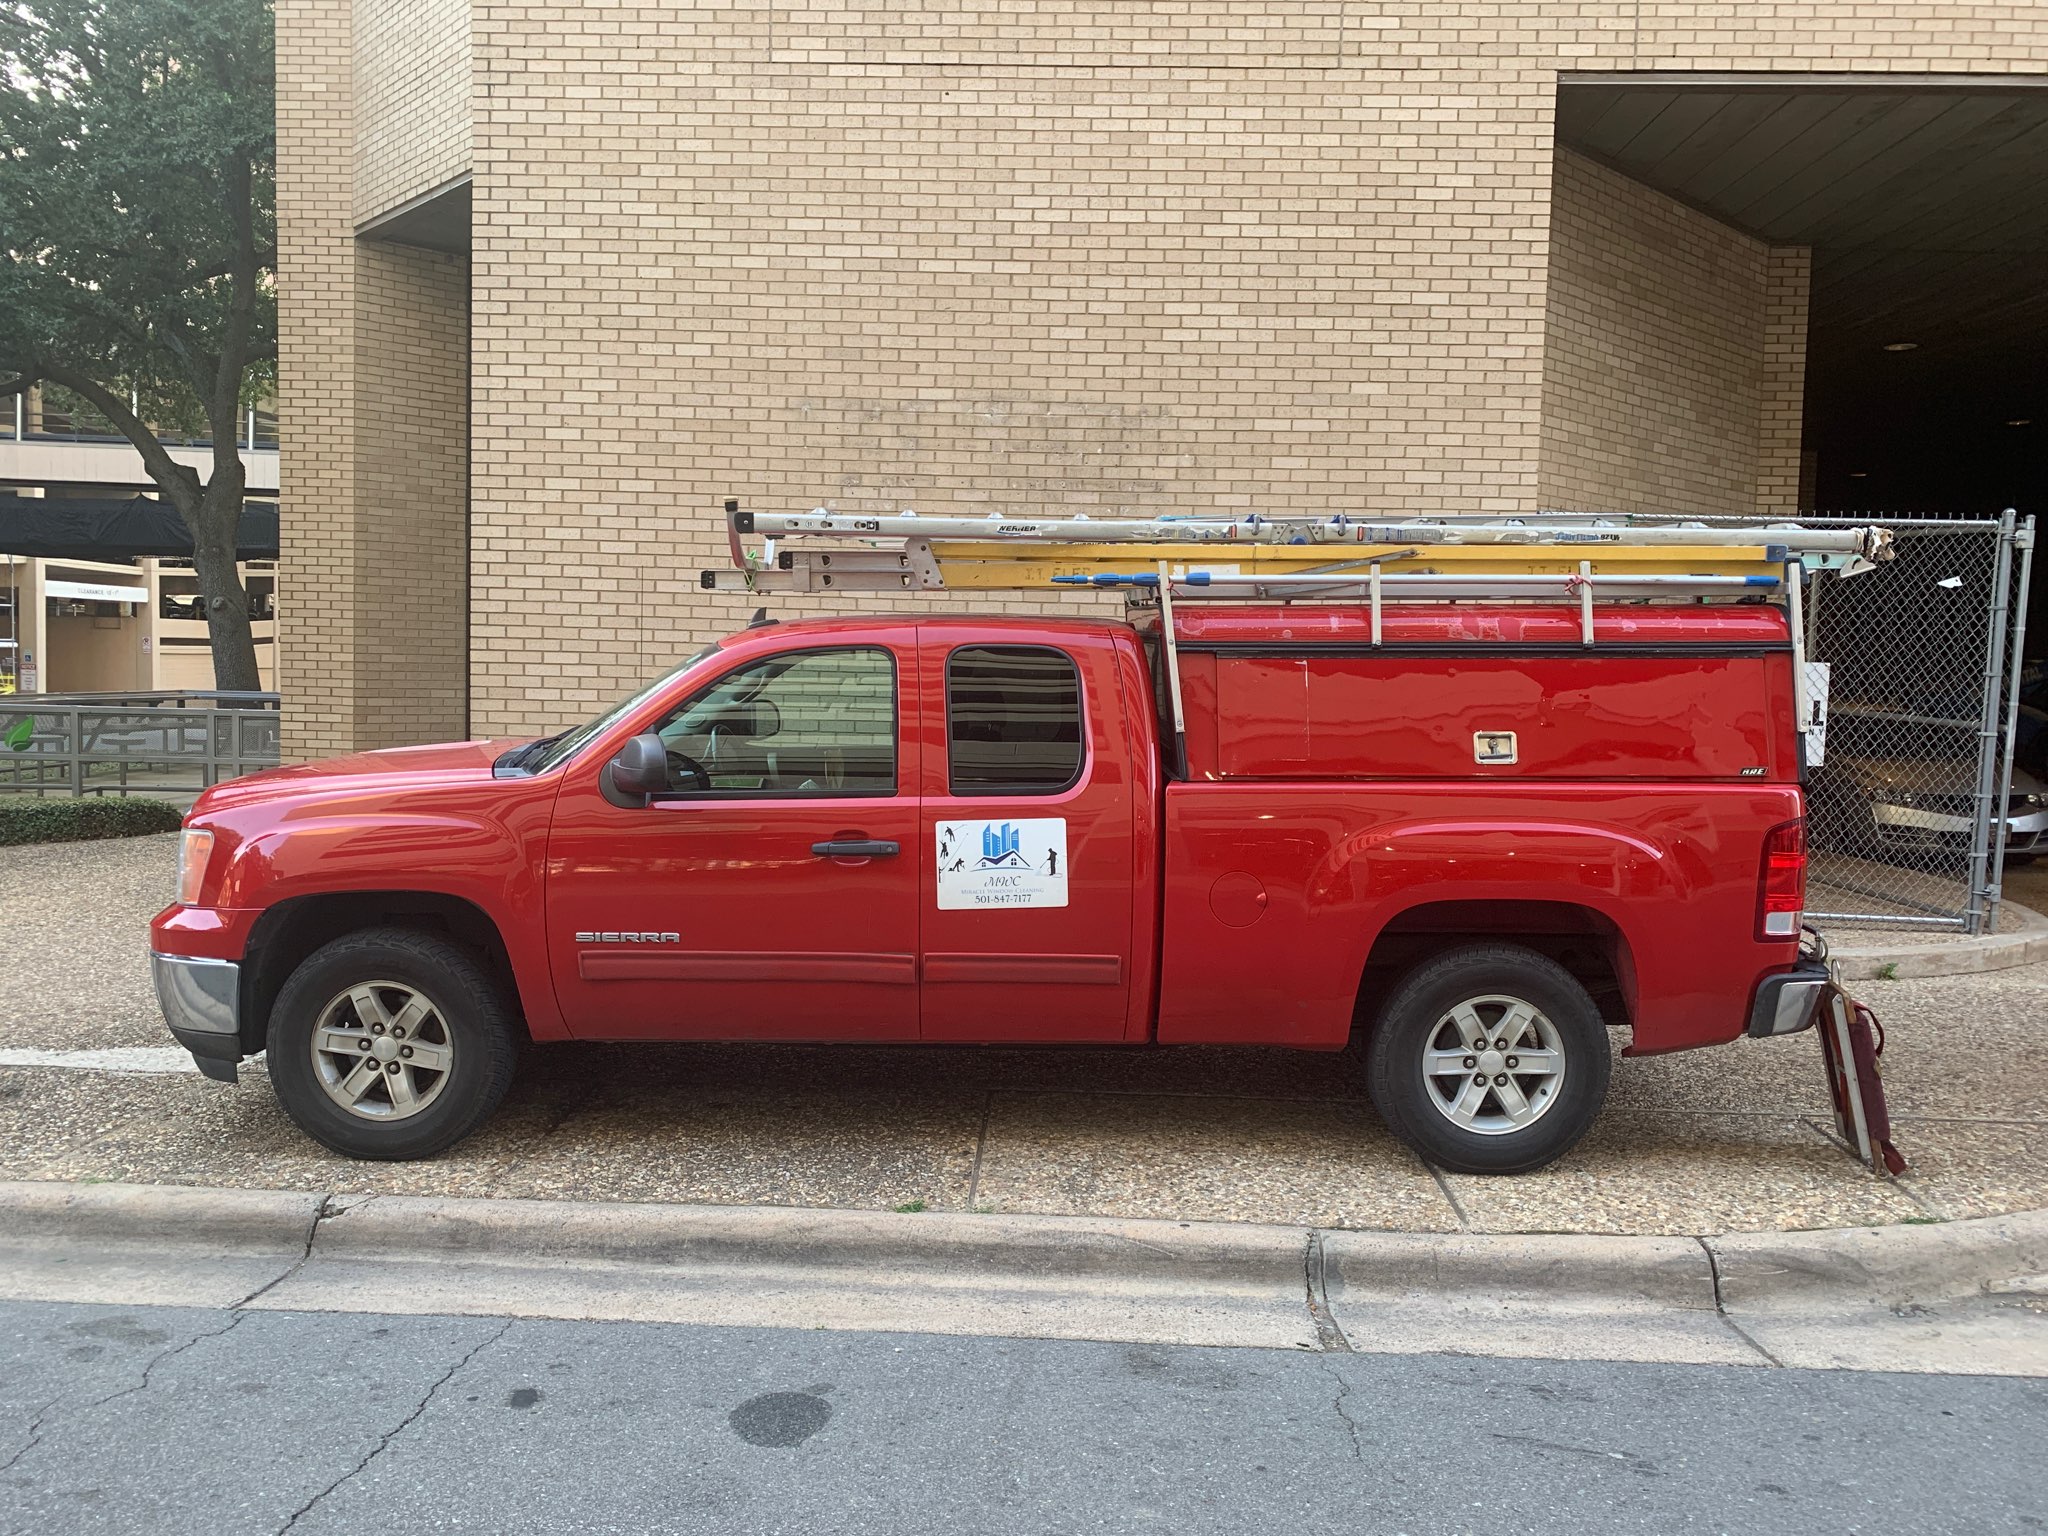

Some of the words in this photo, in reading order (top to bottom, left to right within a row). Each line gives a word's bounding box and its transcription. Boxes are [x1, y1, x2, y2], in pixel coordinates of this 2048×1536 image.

[984, 875, 1022, 887] MWC
[974, 894, 1032, 904] 501-847-7177
[575, 932, 680, 943] SIERRA
